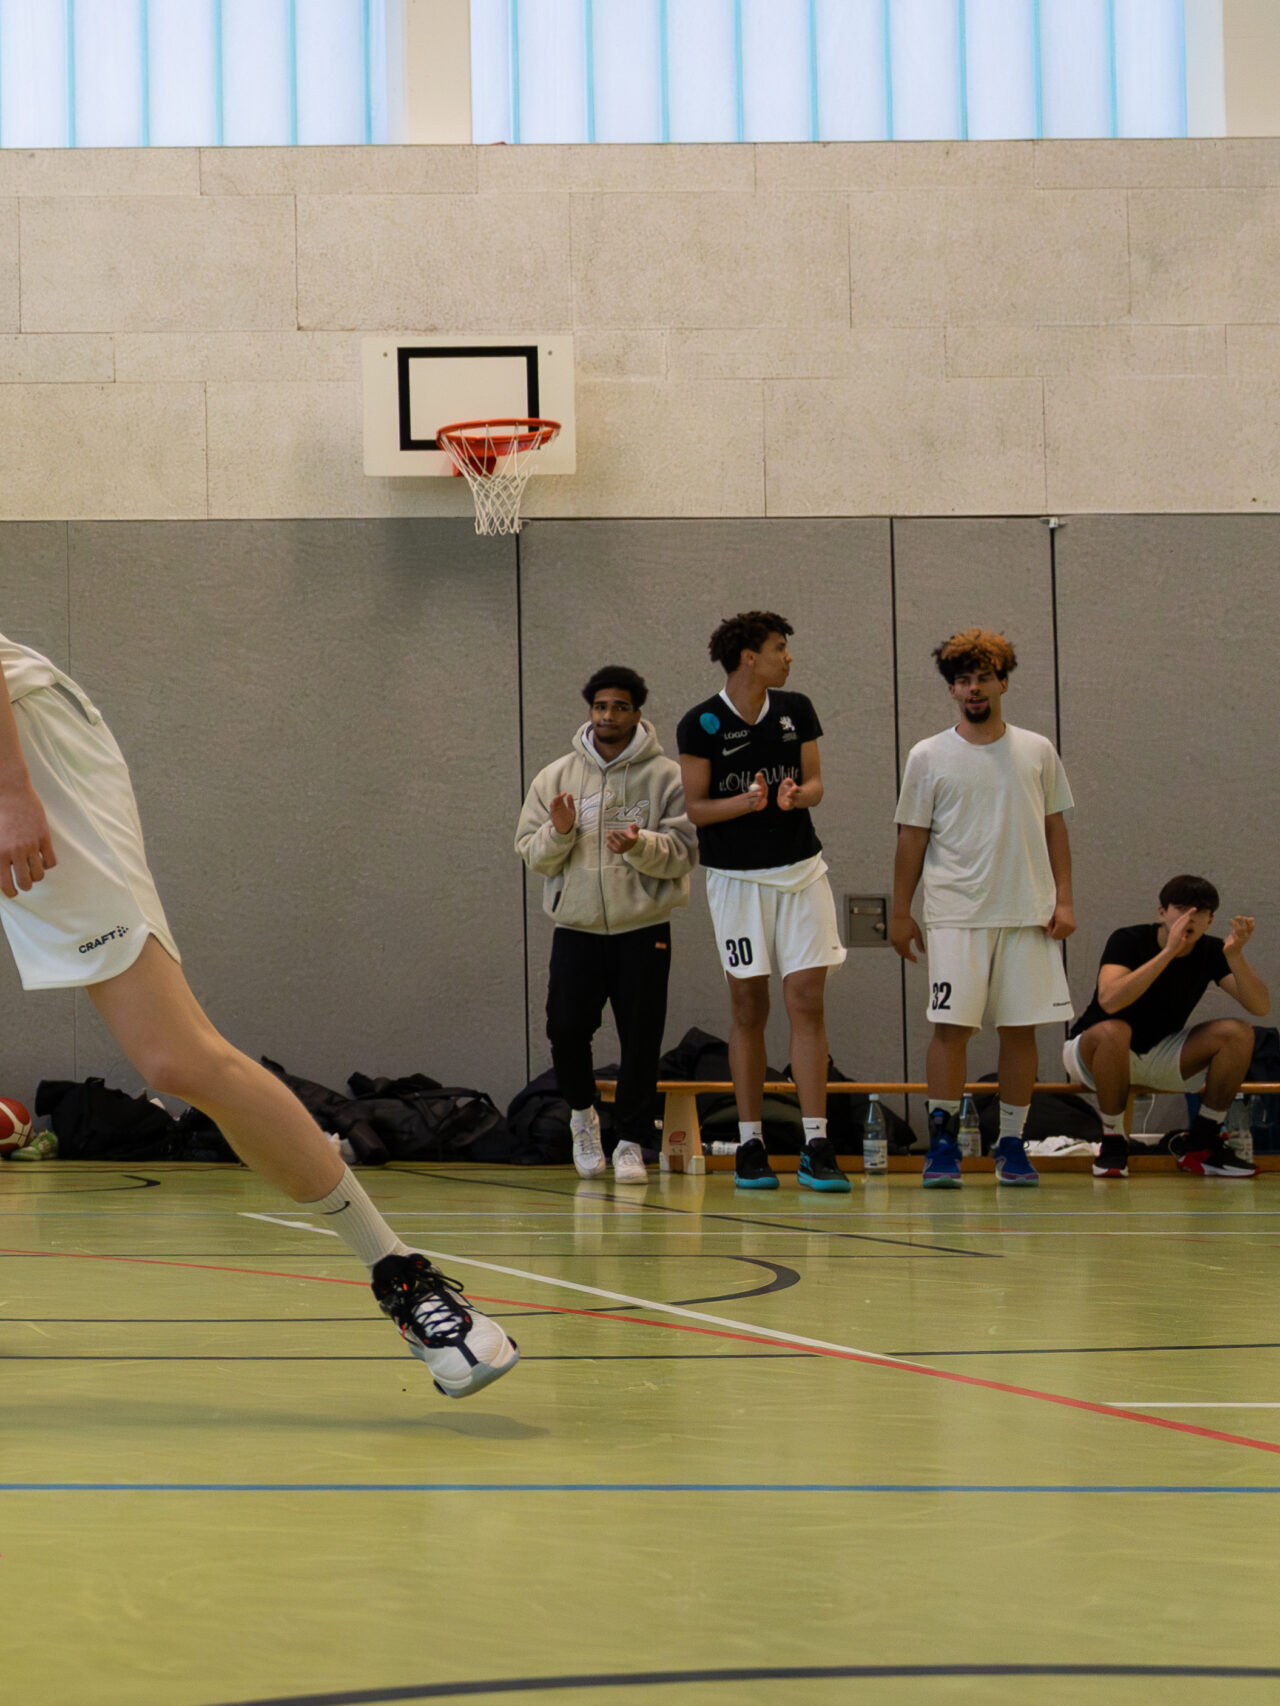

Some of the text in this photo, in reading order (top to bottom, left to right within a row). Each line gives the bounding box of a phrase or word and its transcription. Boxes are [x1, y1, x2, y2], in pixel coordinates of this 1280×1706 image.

[78, 930, 117, 954] CRAFT
[725, 936, 754, 968] 30
[931, 981, 952, 1011] 32
